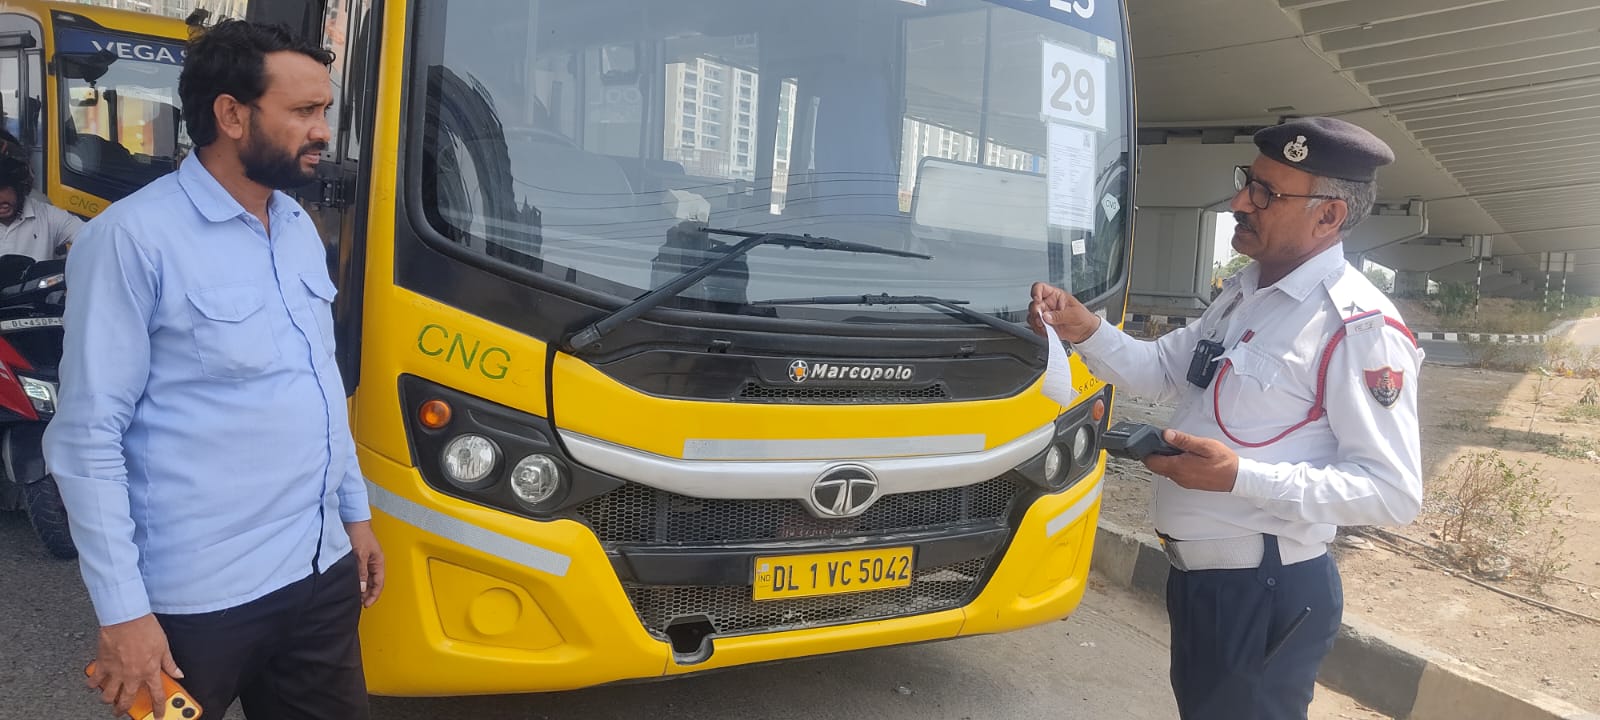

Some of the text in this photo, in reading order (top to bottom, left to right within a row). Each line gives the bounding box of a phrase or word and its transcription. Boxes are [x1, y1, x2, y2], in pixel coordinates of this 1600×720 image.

[92, 40, 177, 63] VEGA
[1050, 61, 1096, 117] 29
[69, 194, 99, 214] CNG
[417, 323, 511, 380] CNG
[810, 363, 912, 380] Marcopolo
[772, 556, 910, 592] DL 1 VC 5042
